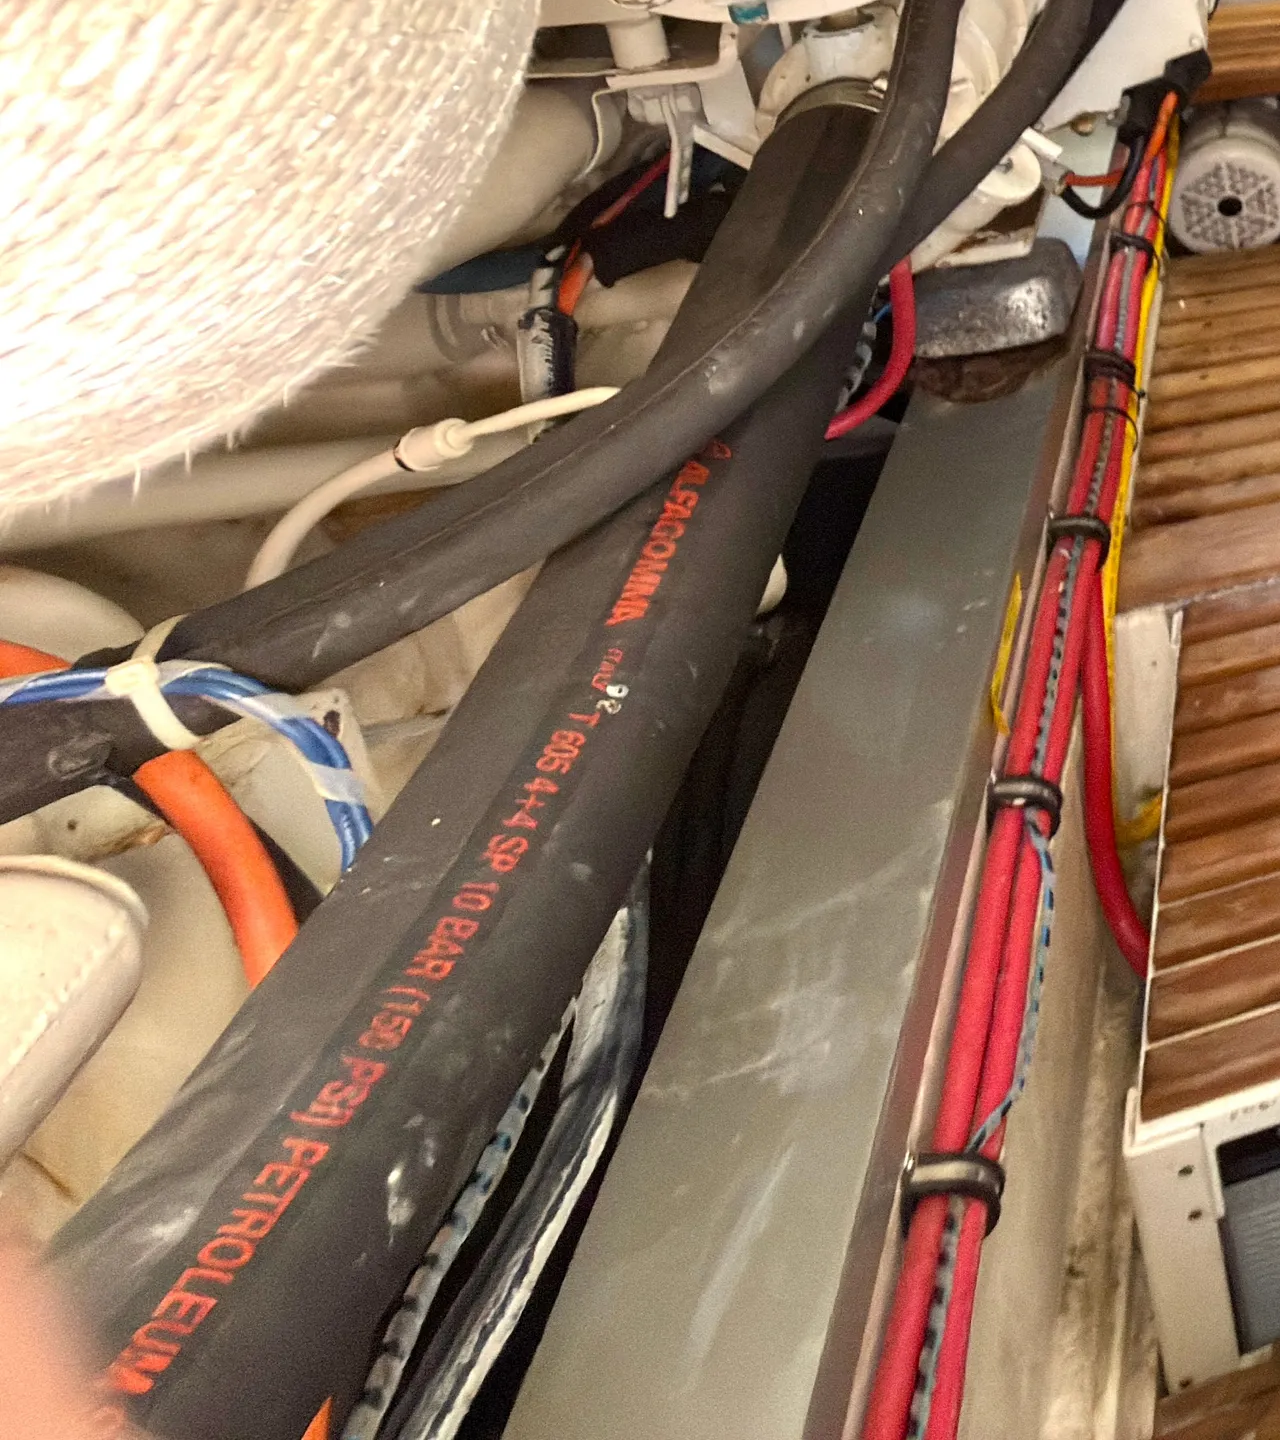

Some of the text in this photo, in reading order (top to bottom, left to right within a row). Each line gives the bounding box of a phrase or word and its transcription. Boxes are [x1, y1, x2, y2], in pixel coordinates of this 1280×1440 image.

[536, 730, 586, 774] 605
[502, 776, 559, 830] 4+4
[481, 833, 529, 873] SP
[452, 881, 499, 911] 10
[403, 916, 480, 981] BAR
[108, 1135, 330, 1395] PETROLEUM
